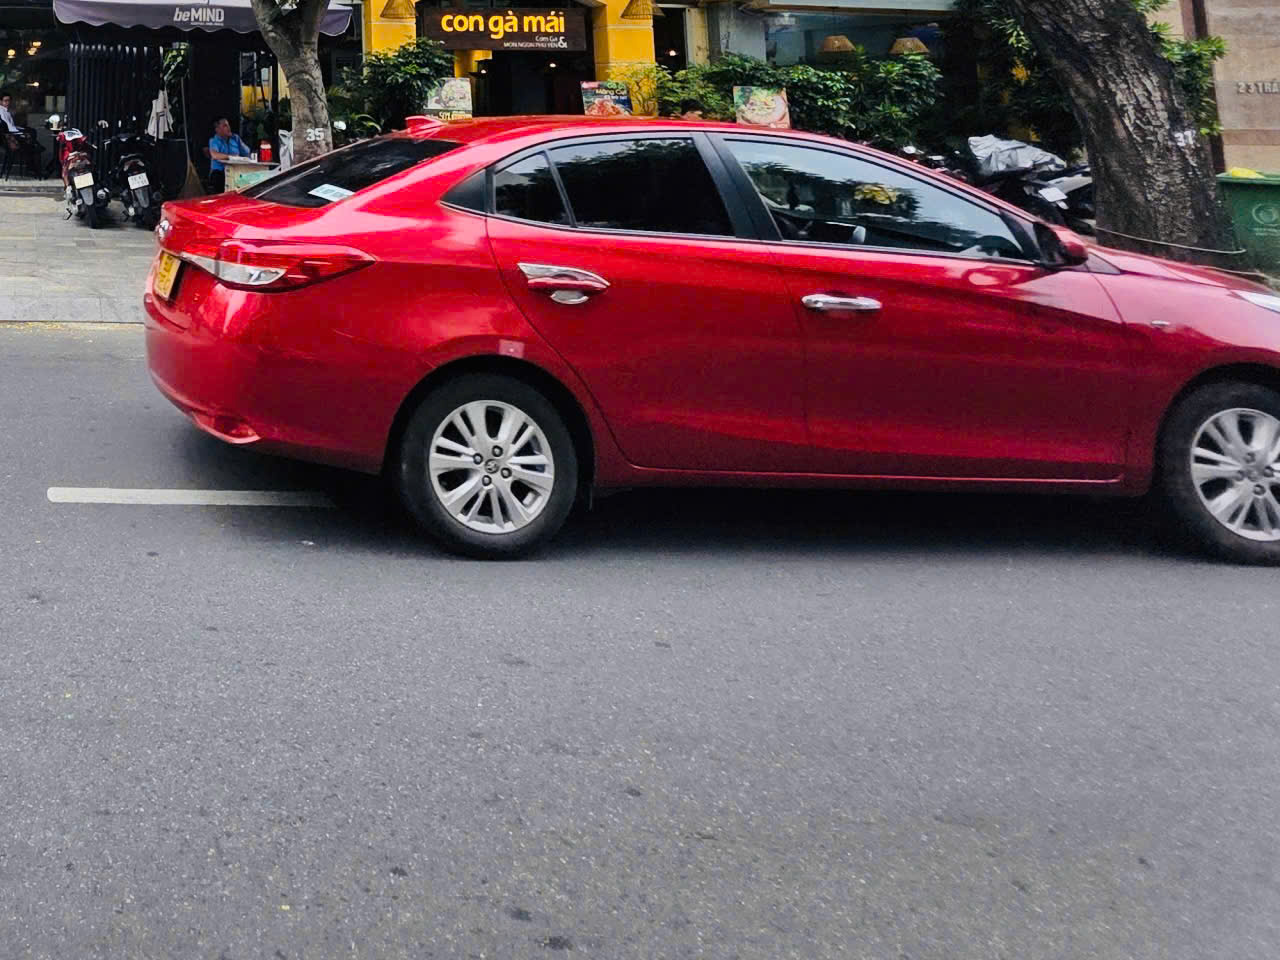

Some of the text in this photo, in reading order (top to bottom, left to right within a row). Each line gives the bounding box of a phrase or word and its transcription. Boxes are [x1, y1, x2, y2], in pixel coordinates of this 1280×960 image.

[173, 7, 225, 22] beMIND
[441, 10, 566, 39] con gà mái
[306, 128, 325, 141] 35
